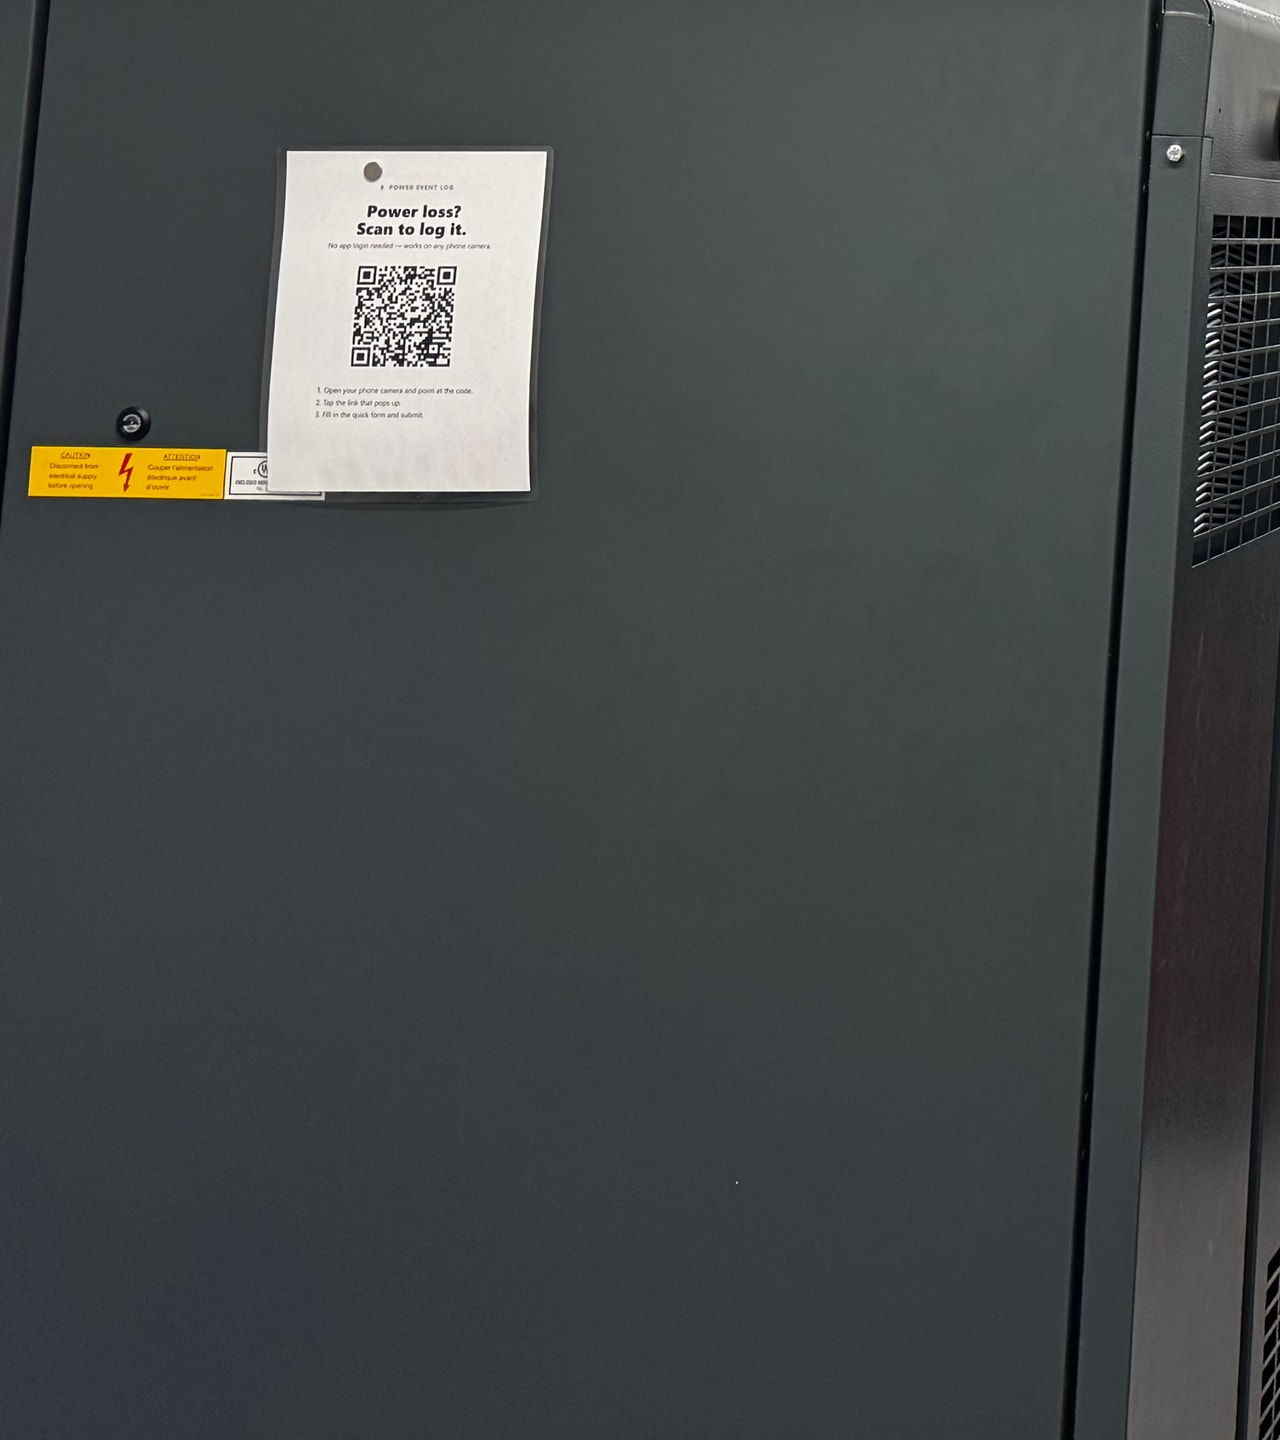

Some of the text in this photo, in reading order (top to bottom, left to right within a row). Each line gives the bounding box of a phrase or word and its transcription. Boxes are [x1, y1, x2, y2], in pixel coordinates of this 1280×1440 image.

[367, 204, 462, 218] Power loss?
[357, 222, 466, 238] Scan to log it.
[446, 242, 466, 250] phone
